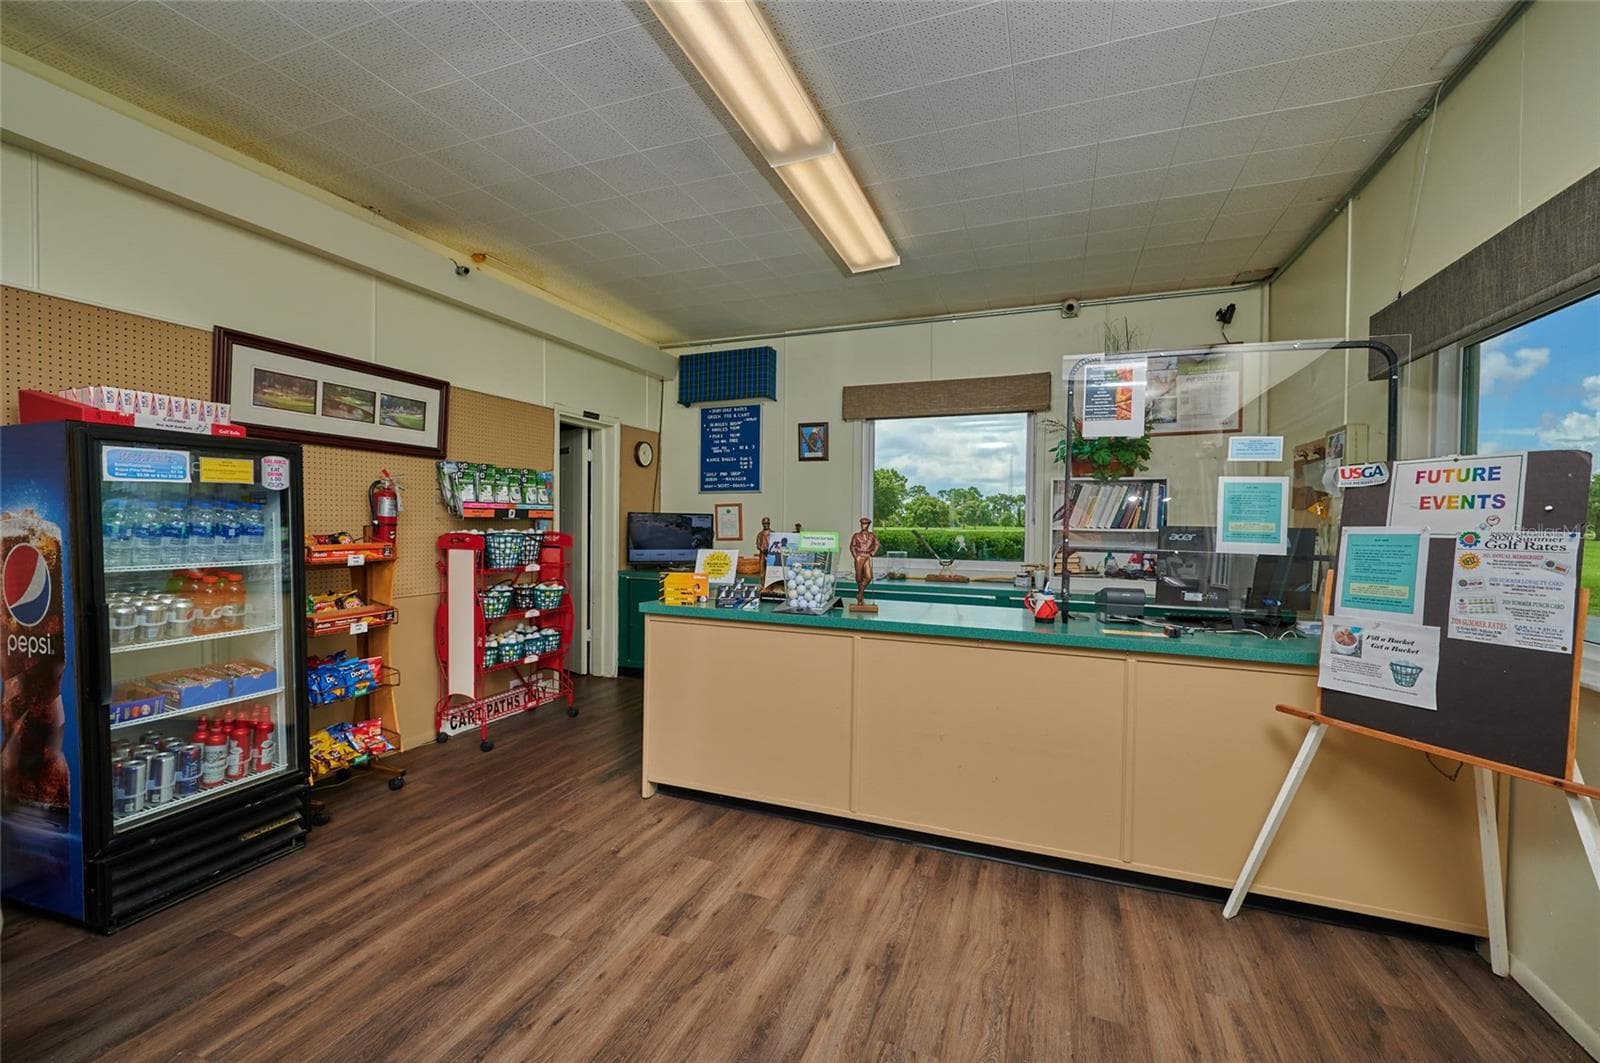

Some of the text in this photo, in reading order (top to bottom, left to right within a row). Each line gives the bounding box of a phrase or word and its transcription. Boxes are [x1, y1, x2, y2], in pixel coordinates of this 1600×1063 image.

[1340, 466, 1384, 480] USGA
[1416, 466, 1502, 484] FUTURE
[1419, 493, 1506, 511] EVENTS
[1168, 532, 1196, 541] acer
[1516, 534, 1565, 544] Summer
[1484, 540, 1567, 552] Golf Rates
[8, 634, 51, 658] pepsi
[1366, 634, 1380, 642] Fill
[1387, 637, 1416, 646] Bucket
[1391, 646, 1420, 654] Bucket
[450, 685, 548, 730] CART PATHS ONLY
